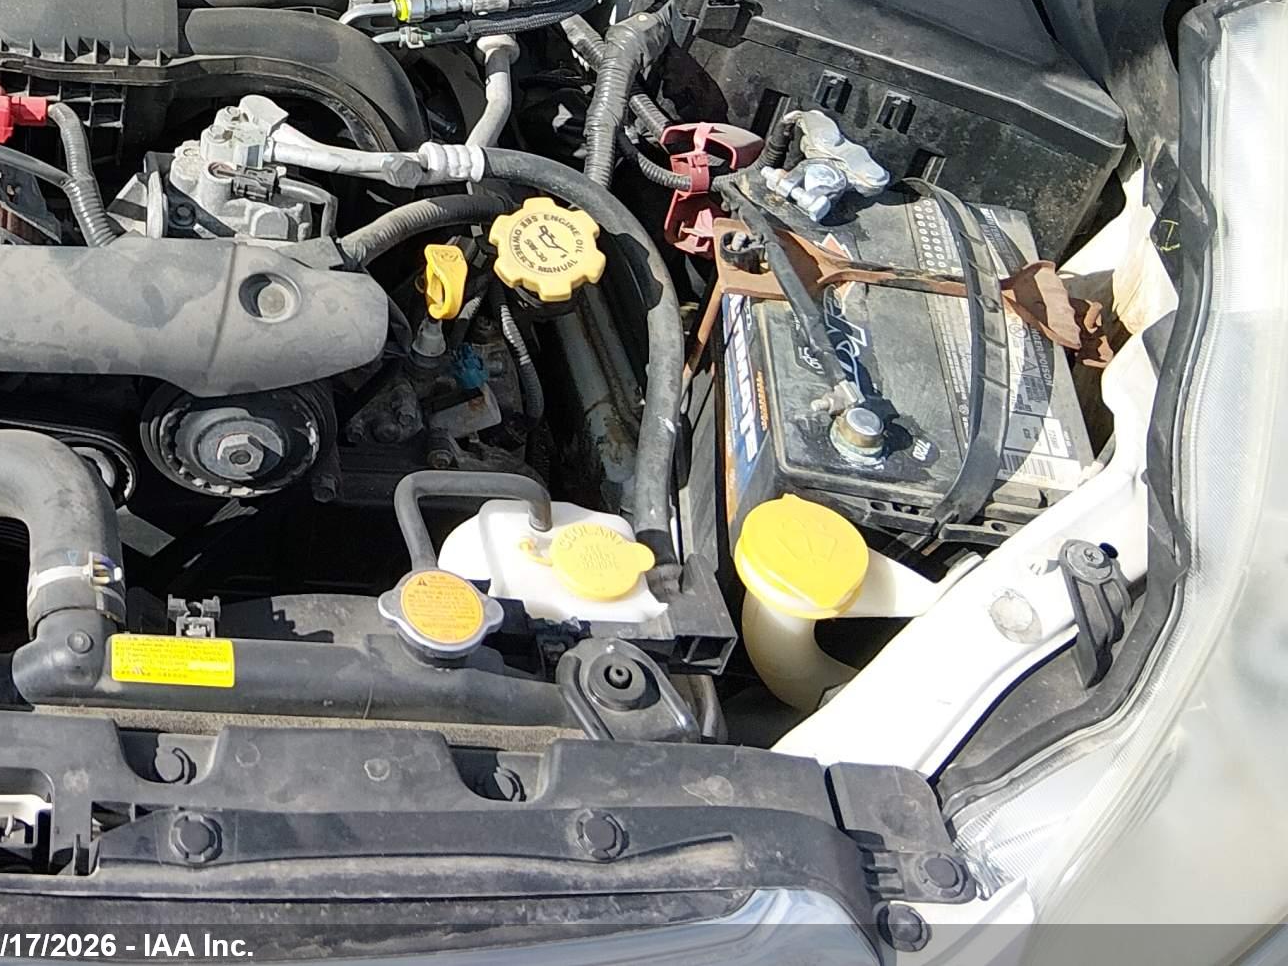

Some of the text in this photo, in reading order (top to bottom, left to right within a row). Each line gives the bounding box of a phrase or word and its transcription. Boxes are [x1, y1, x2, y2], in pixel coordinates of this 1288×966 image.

[520, 215, 538, 228] SEE
[538, 258, 578, 273] MANUAL
[544, 214, 584, 254] ENGINE OIL
[912, 437, 932, 462] 7/20
